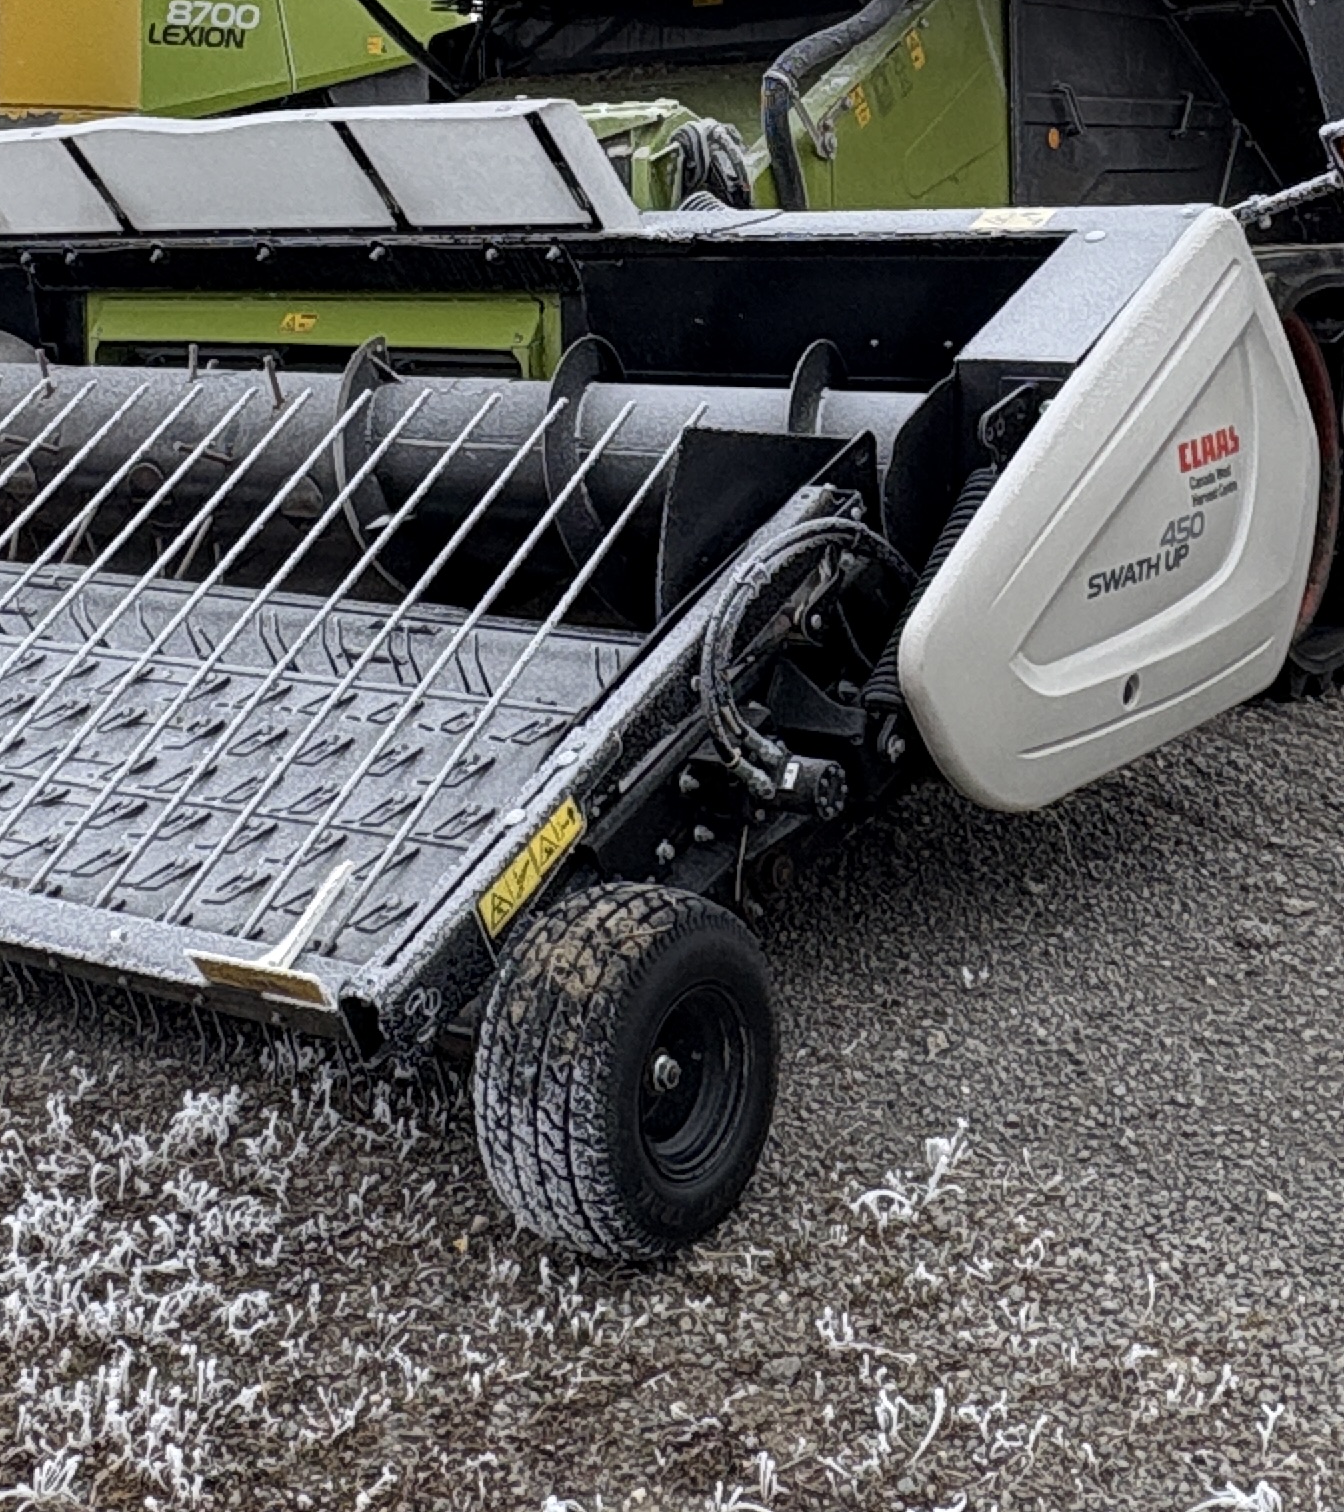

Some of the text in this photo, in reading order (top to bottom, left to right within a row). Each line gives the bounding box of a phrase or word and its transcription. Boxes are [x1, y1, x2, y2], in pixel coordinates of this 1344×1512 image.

[167, 0, 260, 30] 8700
[148, 22, 246, 49] LEXION
[1178, 425, 1240, 474] CLAAS
[1160, 510, 1205, 548] 450
[1087, 543, 1189, 600] SWATH UP
